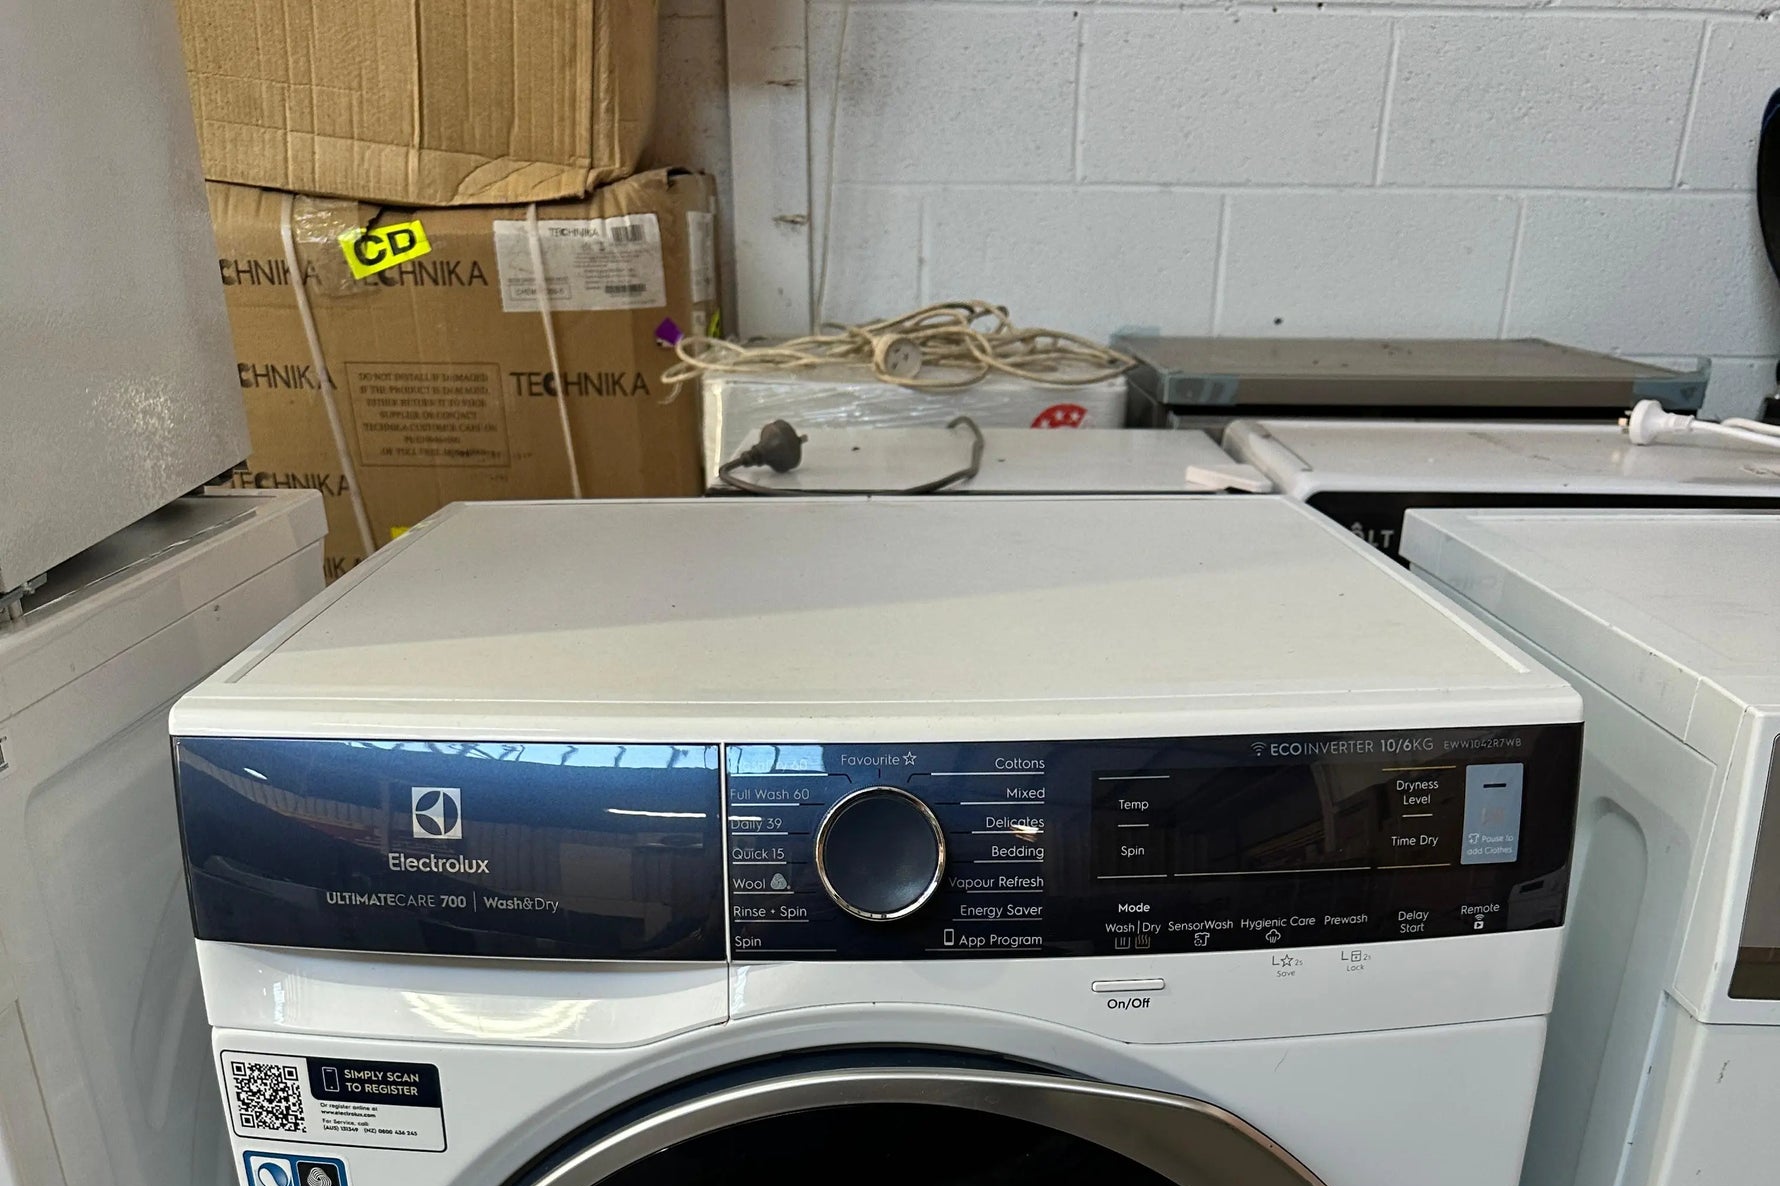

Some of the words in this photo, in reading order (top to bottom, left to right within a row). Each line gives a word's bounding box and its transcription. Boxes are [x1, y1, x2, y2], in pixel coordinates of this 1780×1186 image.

[353, 228, 417, 266] CD
[510, 371, 650, 397] TECHNIKA
[1270, 740, 1374, 756] ECOINVERTER
[1380, 737, 1434, 752] 10/6KG
[840, 754, 900, 766] Favourite
[995, 757, 1045, 769] Cottons
[1006, 787, 1045, 798] Mixed
[1396, 780, 1439, 793] Dryness
[730, 788, 751, 799] Full
[755, 788, 789, 799] Wash
[793, 788, 810, 799] 60
[1118, 799, 1149, 811] Temp
[1403, 795, 1431, 805] Level
[730, 818, 762, 831] Daily
[766, 818, 782, 830] 39
[986, 816, 1045, 829] Delicates
[1391, 836, 1416, 847] Time
[1420, 835, 1439, 847] Dry
[732, 848, 769, 860] Quick
[772, 848, 785, 859] 15
[991, 845, 1044, 859] Bedding
[1120, 845, 1145, 858] Spin
[388, 853, 490, 874] Electrolux
[732, 878, 766, 890] Wool
[950, 877, 995, 889] Vapour
[998, 876, 1044, 888] Refresh
[326, 891, 435, 908] ULTIMATECARE
[440, 896, 467, 908] 700
[483, 896, 559, 914] Wash&Dry
[1118, 903, 1151, 913] Mode
[733, 905, 766, 917] Rinse
[780, 905, 807, 919] Spin
[960, 904, 1003, 918] Energy
[1006, 904, 1043, 916] Saver
[1460, 903, 1500, 915] Remote
[1240, 917, 1287, 930] Hygienic
[1289, 915, 1316, 926] Care
[1324, 914, 1368, 925] Prewash
[1398, 911, 1429, 922] Delay
[1105, 922, 1135, 932] Wash
[1142, 921, 1161, 933] Dry
[1168, 919, 1234, 931] SensorWash
[1400, 923, 1425, 933] Start
[734, 935, 762, 949] Spin
[959, 936, 986, 947] App
[989, 934, 1043, 948] Program
[1276, 969, 1296, 977] Save
[1107, 998, 1151, 1009] On/Off
[344, 1069, 384, 1080] SIMPLY
[386, 1071, 420, 1082] SCAN
[345, 1082, 362, 1092] TO
[364, 1083, 419, 1096] REGISTER
[321, 1109, 376, 1118] www.electrolux.com
